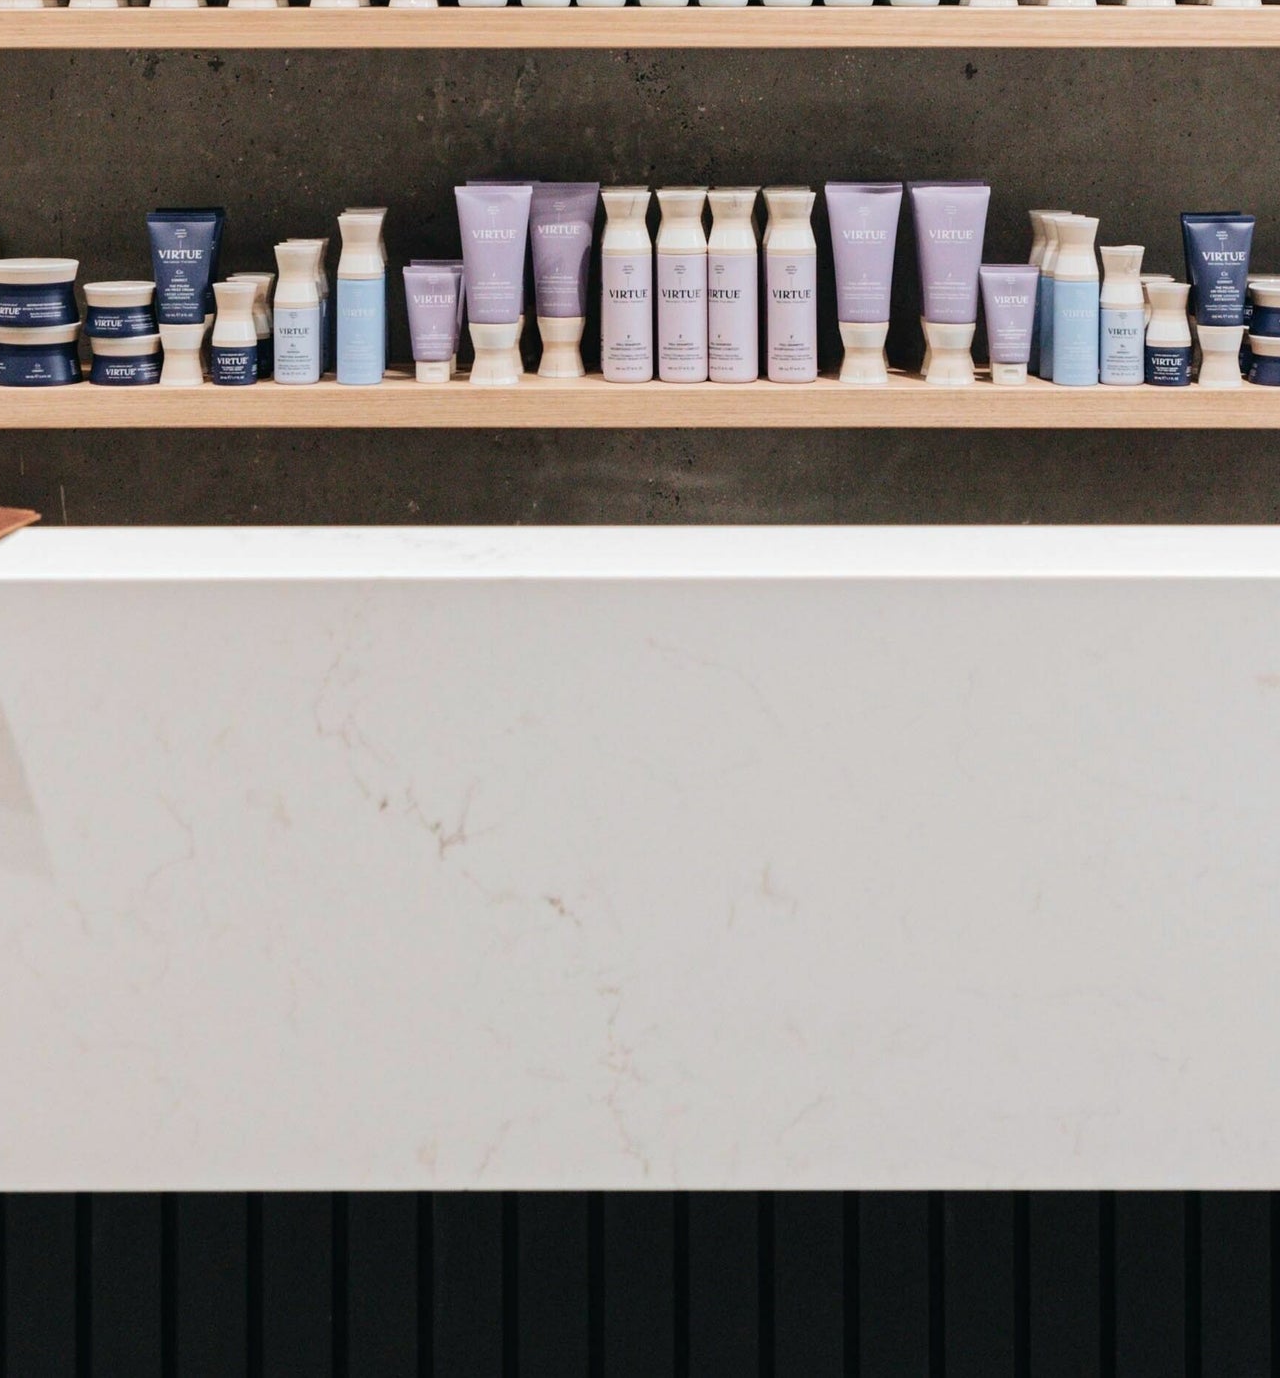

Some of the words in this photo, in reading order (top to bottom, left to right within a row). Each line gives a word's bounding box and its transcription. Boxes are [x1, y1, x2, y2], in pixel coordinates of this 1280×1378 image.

[472, 230, 517, 240] VIRTUE
[537, 225, 582, 236] VIRTUE
[842, 230, 888, 240] VIRTUE
[928, 230, 974, 240] VIRTUE
[158, 250, 204, 260] VIRTUE
[1202, 252, 1246, 262] VIRTUE
[414, 294, 454, 304] VIRTUE
[609, 289, 648, 299] VIRTUE
[662, 289, 702, 299] VIRTUE
[708, 289, 742, 299] IRTUE
[772, 289, 812, 299] VIRTUE
[994, 295, 1030, 304] VIRTUE
[94, 319, 124, 328] VIRTUE
[279, 327, 309, 336] VIRTUE
[1108, 328, 1138, 336] VIRTUE
[217, 356, 249, 366] VIRTUE
[1152, 357, 1182, 366] VIRTUE
[106, 368, 136, 376] VIRTUE
